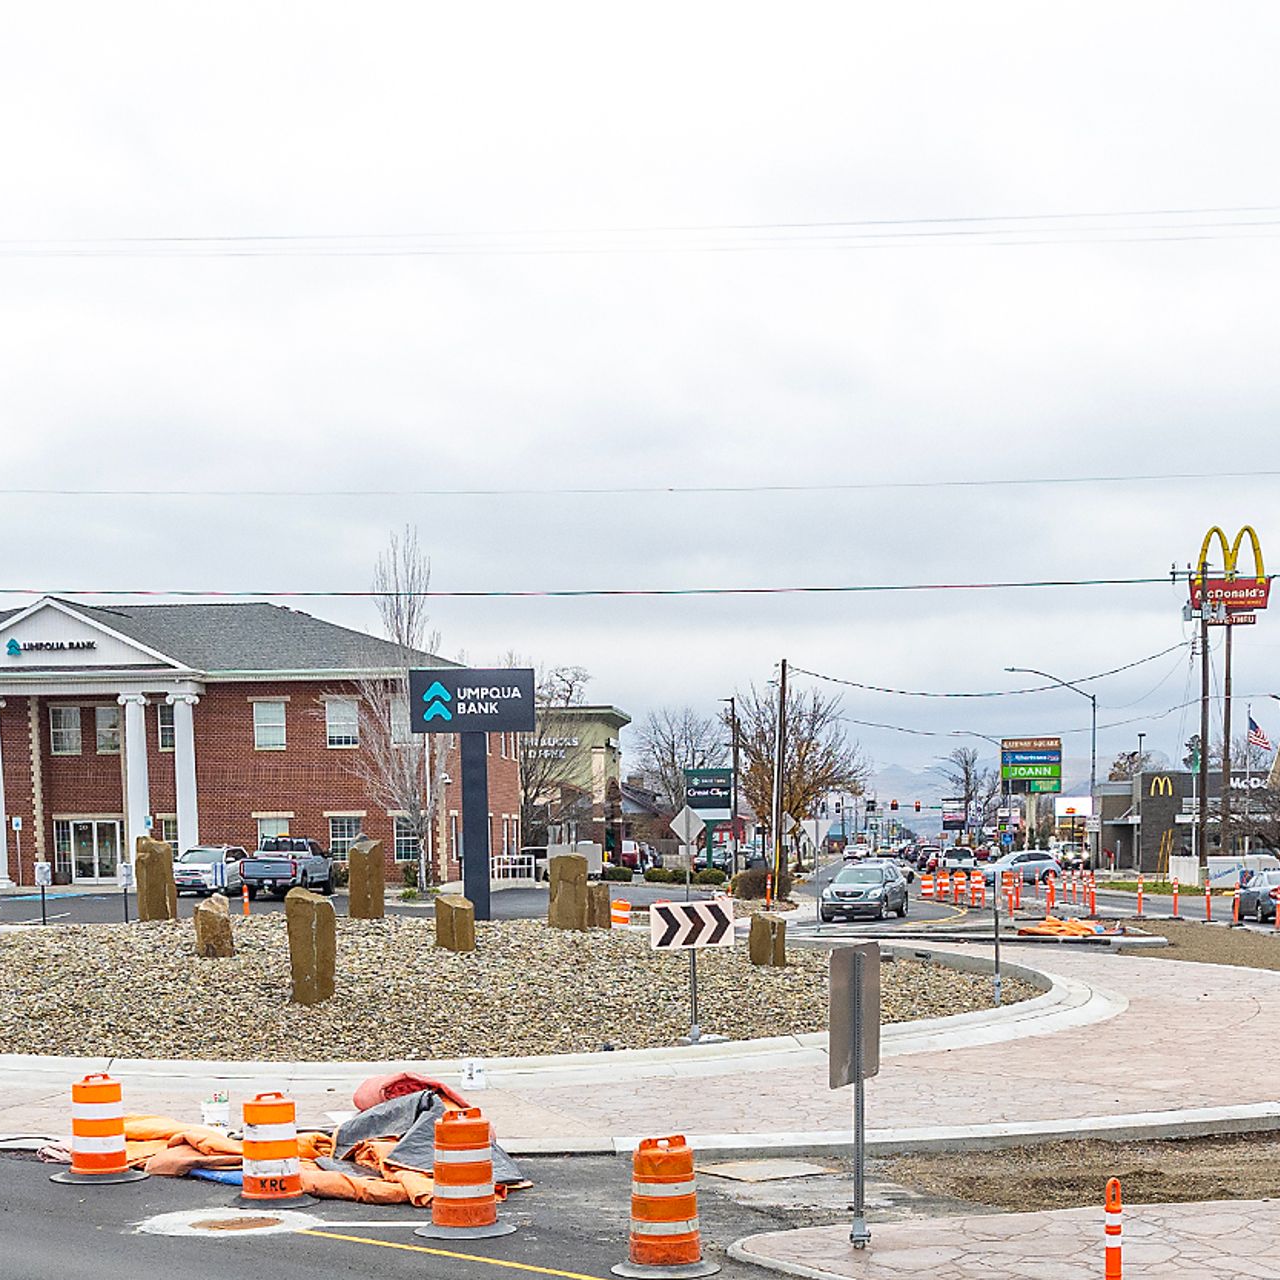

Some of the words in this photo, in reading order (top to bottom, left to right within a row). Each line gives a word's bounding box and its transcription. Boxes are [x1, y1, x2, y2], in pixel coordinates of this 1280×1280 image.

[22, 641, 65, 652] UMPQUA
[67, 640, 97, 651] BANK
[456, 686, 522, 700] UMPQUA
[456, 702, 499, 714] BANK
[1011, 766, 1052, 777] JOANN
[687, 788, 709, 797] Great
[260, 1178, 287, 1192] KRC
